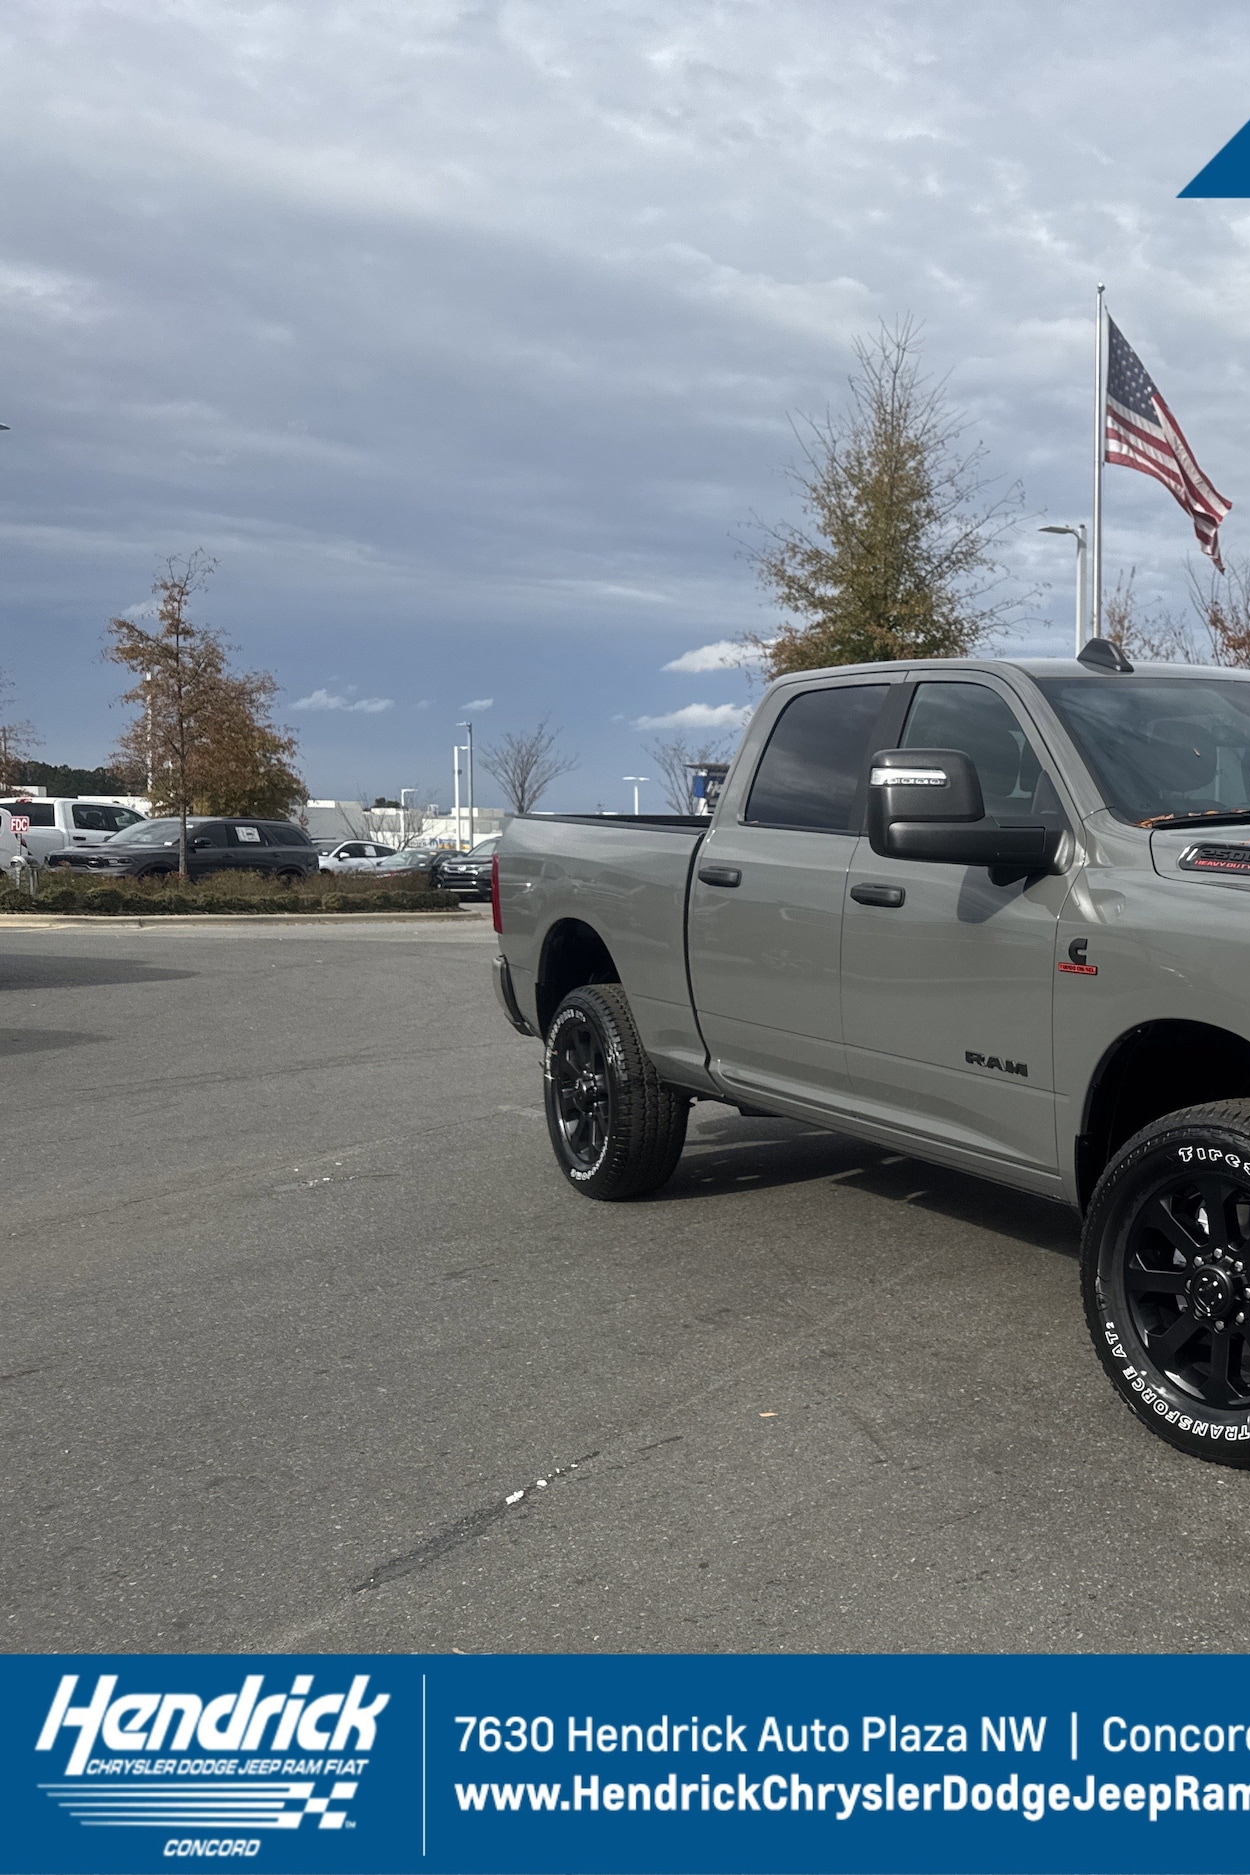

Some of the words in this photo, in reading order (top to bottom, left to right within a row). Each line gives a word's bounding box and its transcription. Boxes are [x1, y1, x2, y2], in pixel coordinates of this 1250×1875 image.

[11, 818, 27, 830] FDC
[1194, 860, 1226, 868] HEAVY
[965, 1050, 1028, 1077] RAM
[1122, 1366, 1250, 1441] TRANSFORCE
